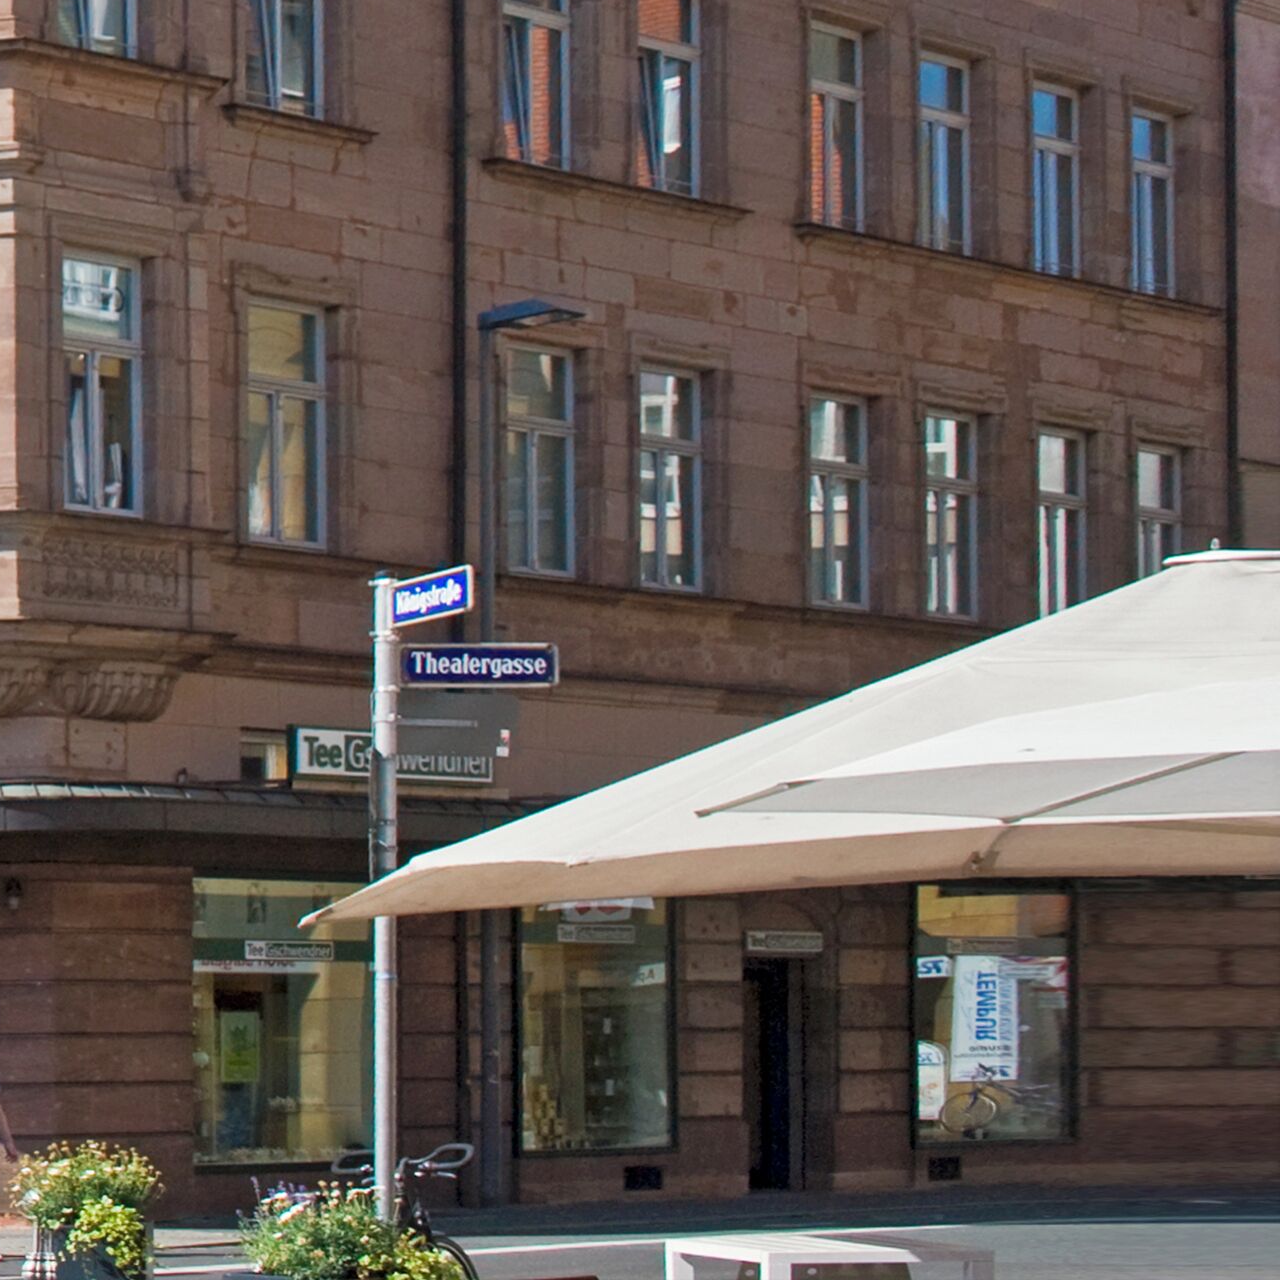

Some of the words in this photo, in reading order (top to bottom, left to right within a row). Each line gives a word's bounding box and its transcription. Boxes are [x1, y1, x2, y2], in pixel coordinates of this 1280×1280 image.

[396, 578, 462, 615] Königstraße
[410, 650, 547, 679] Theatergasse
[302, 736, 343, 769] Tee
[247, 943, 264, 957] Tee
[266, 942, 331, 958] Gschwendner
